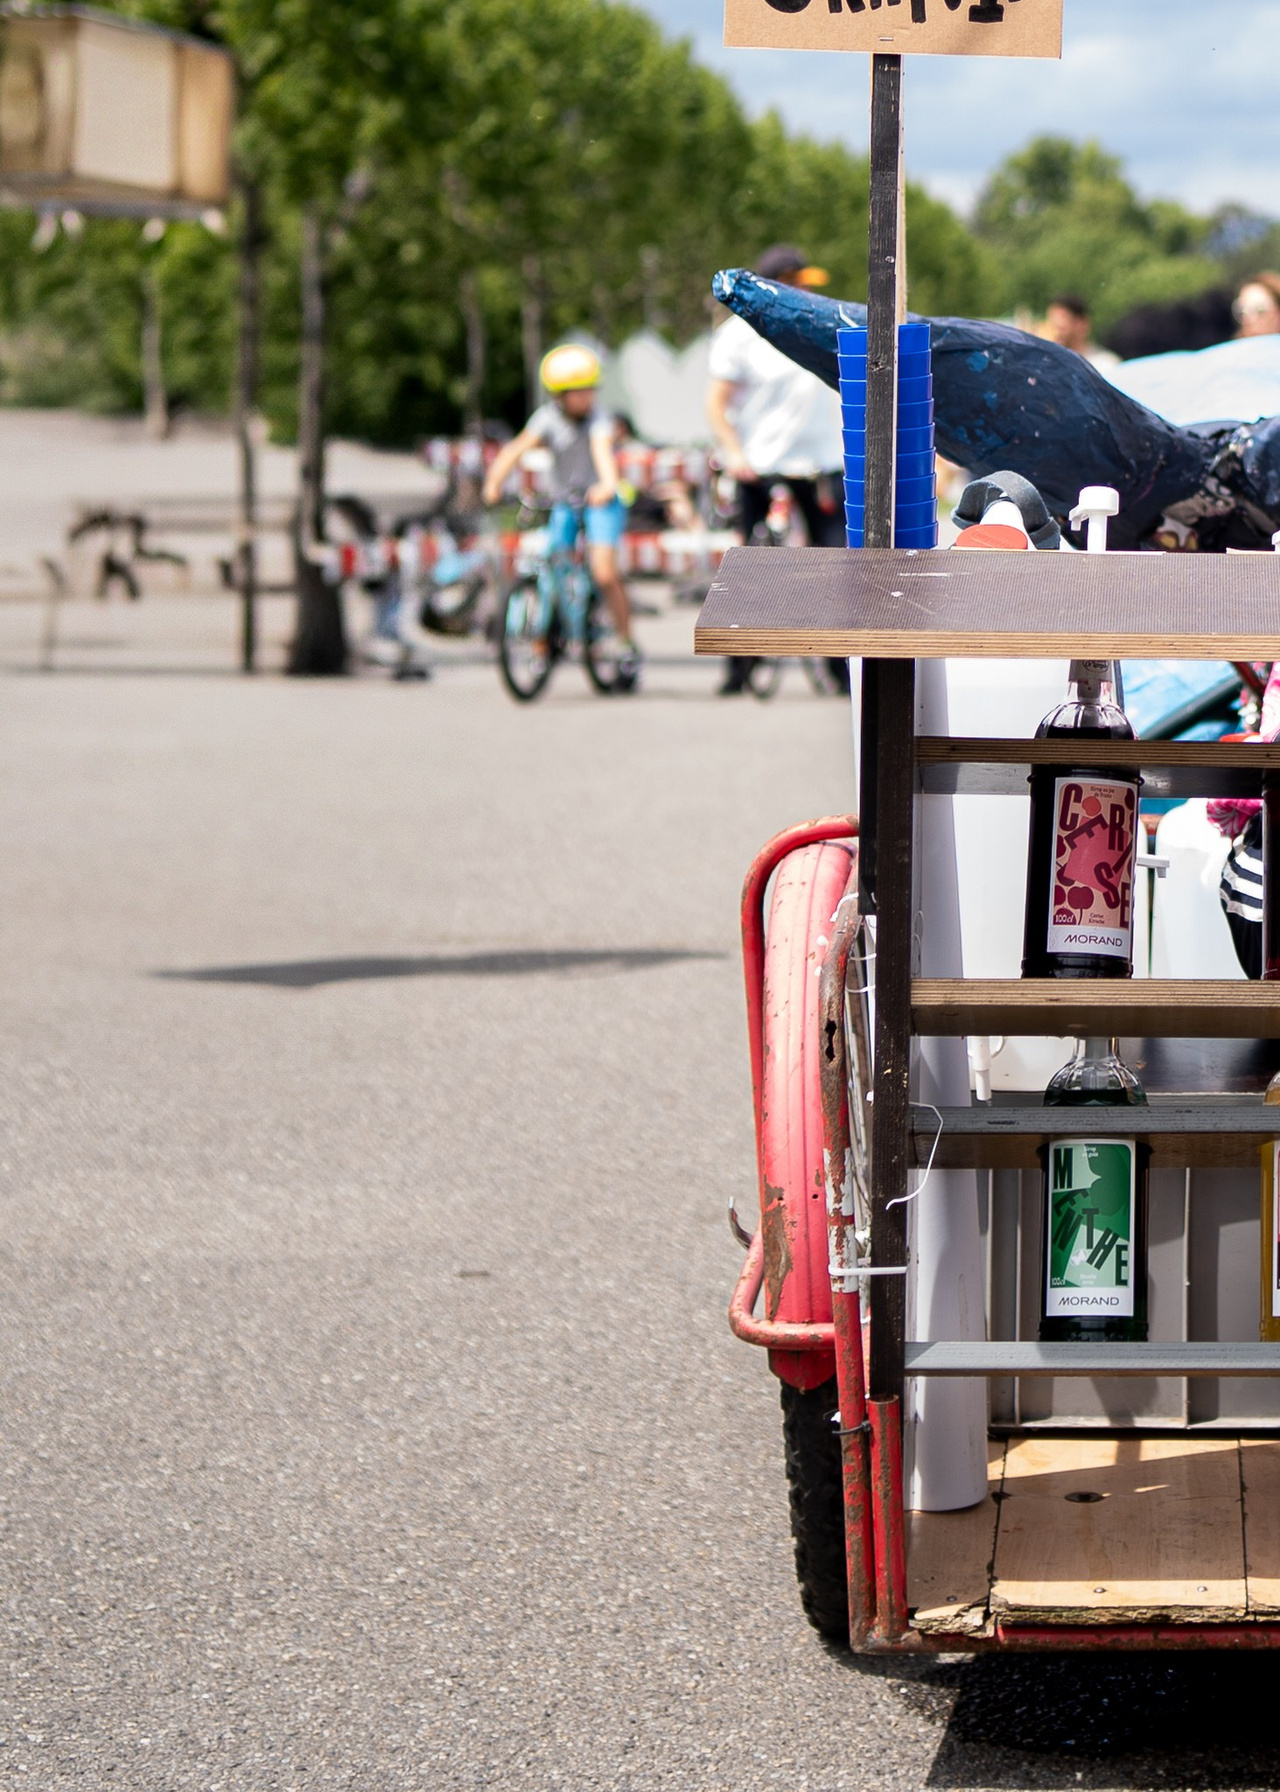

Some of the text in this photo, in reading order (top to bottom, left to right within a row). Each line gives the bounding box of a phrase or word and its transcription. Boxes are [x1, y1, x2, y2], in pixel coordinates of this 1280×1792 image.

[1059, 783, 1133, 929] CERISE
[1055, 913, 1075, 924] 100cl
[1064, 934, 1123, 947] MORAND
[1053, 1147, 1128, 1286] MENTHE
[1058, 1296, 1120, 1306] MORAND
